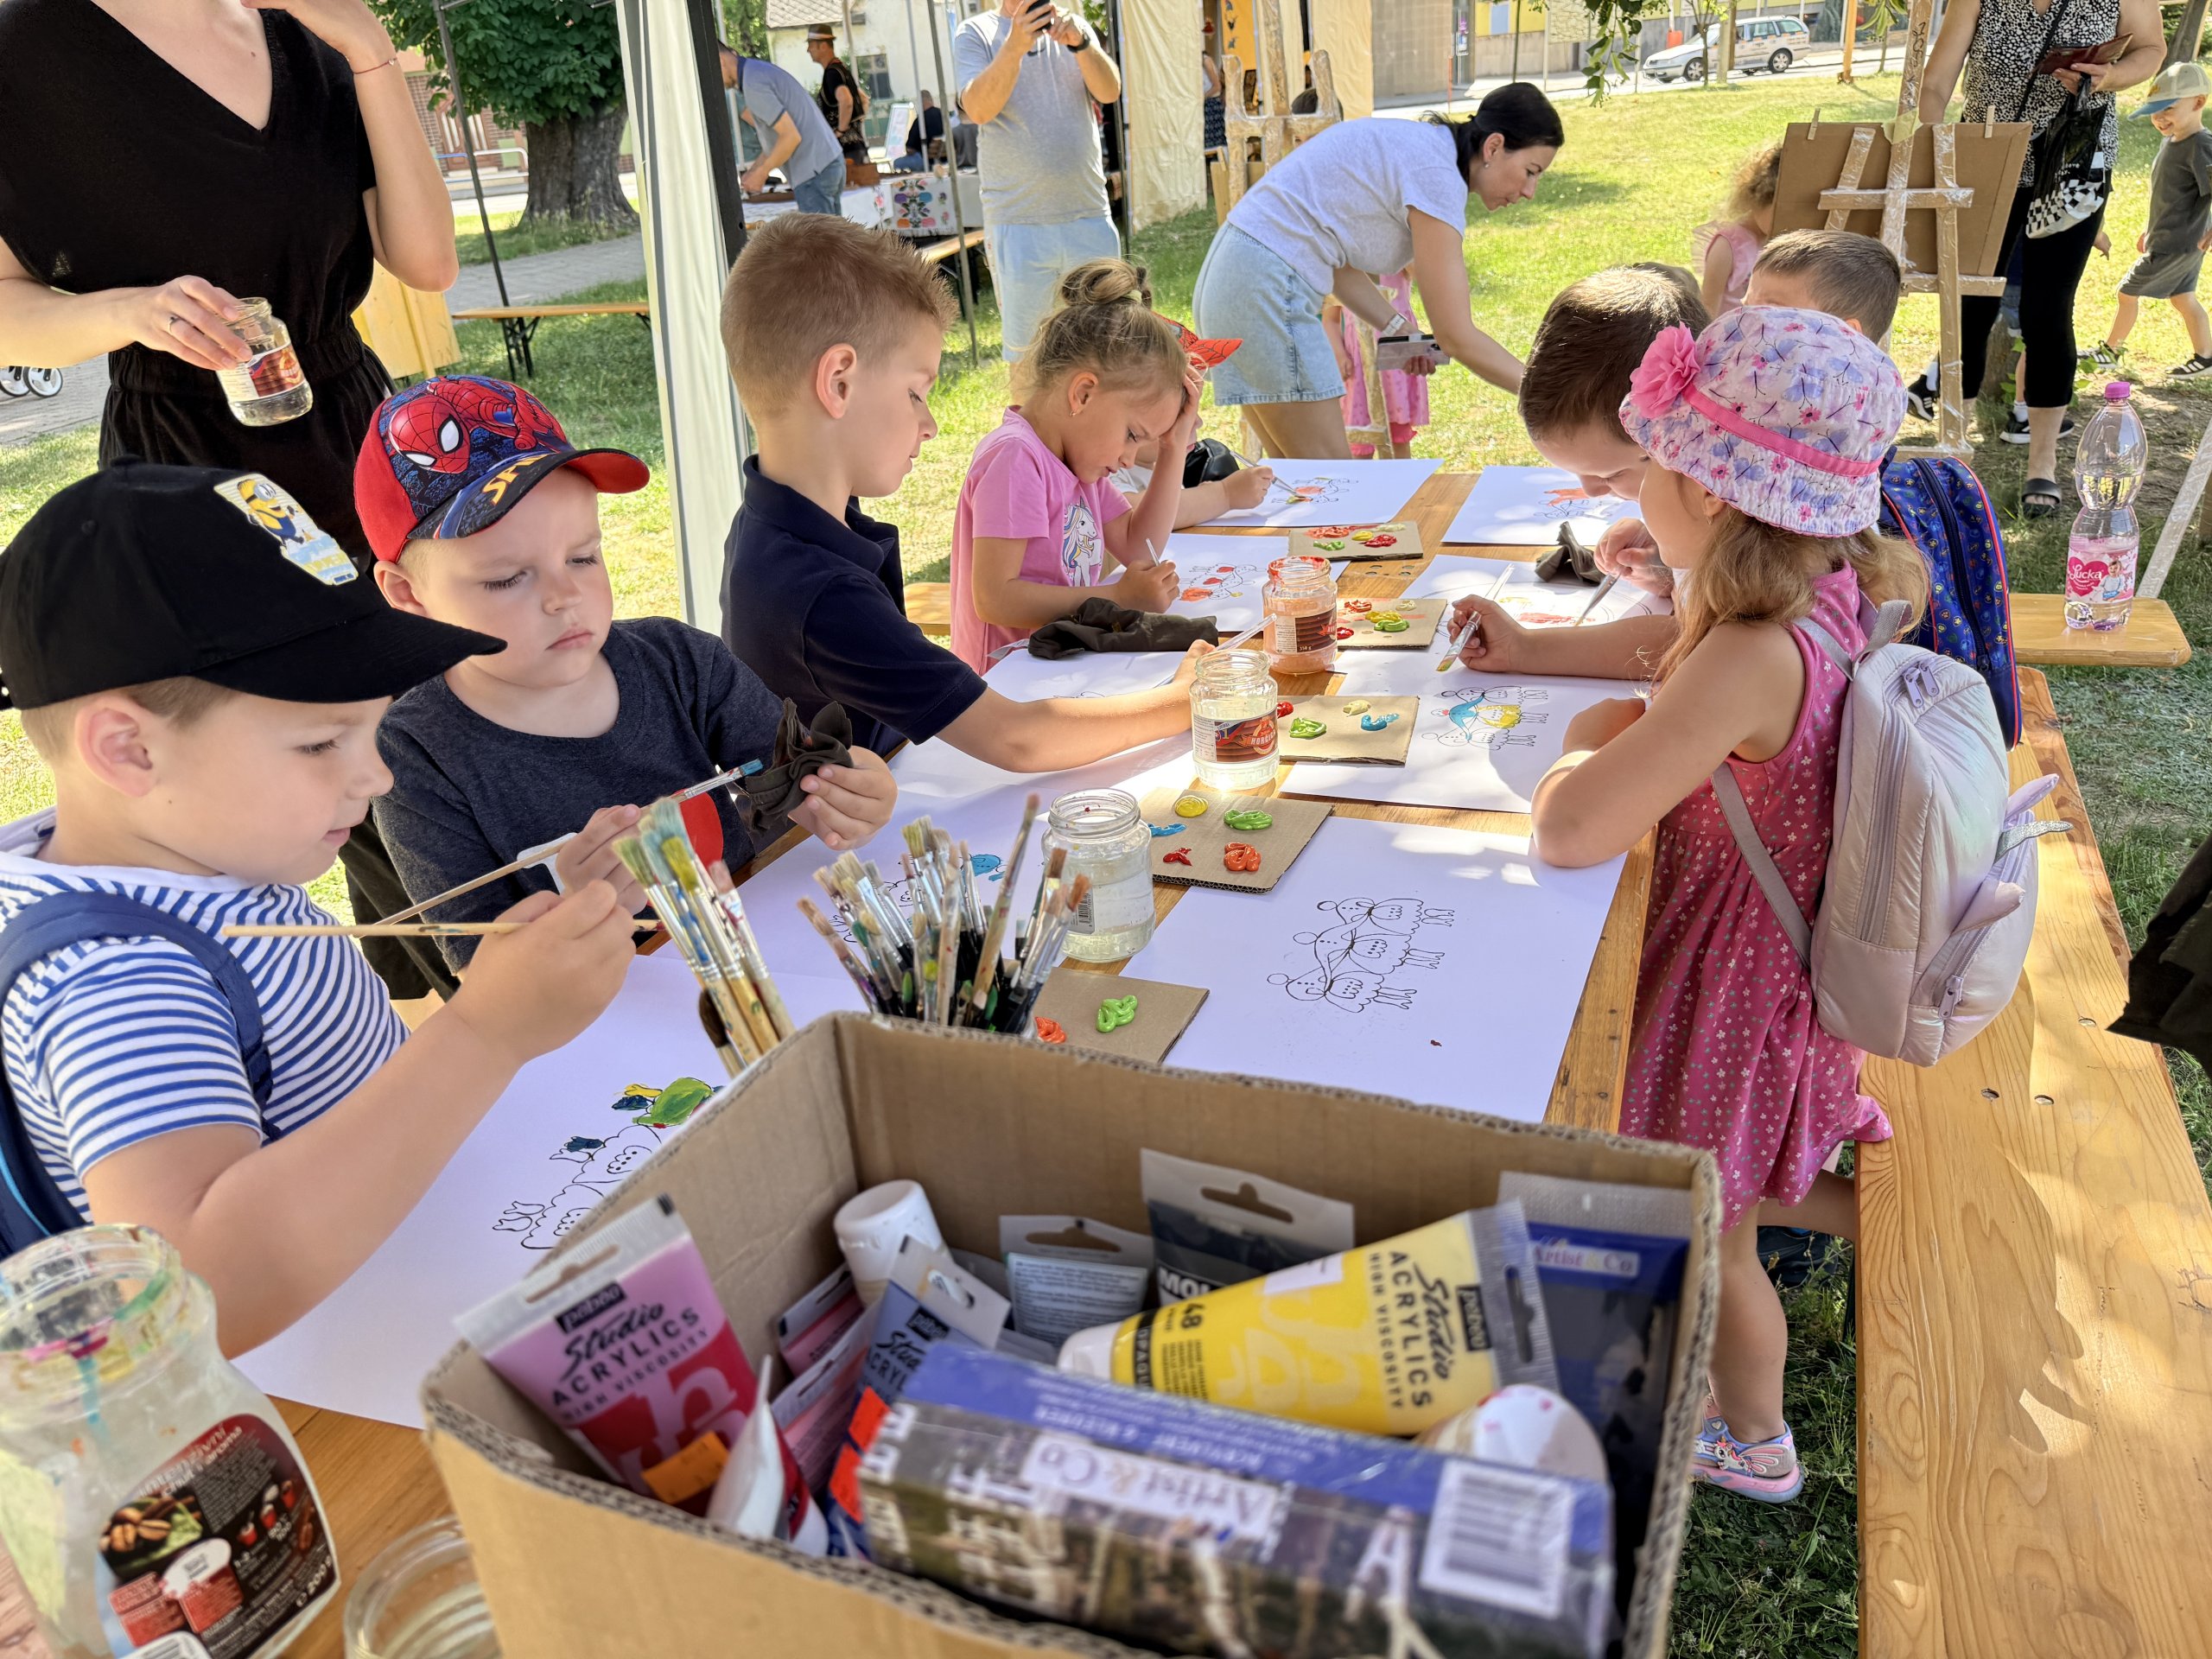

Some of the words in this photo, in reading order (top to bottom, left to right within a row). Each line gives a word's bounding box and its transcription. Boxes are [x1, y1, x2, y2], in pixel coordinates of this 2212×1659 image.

[2069, 564, 2102, 580] Lucka
[550, 1306, 701, 1408] ACRYLICS
[559, 1301, 665, 1383] Studio
[1135, 1328, 1152, 1389] OPAQU
[1369, 1253, 1383, 1300] HIGH
[1376, 1305, 1404, 1409] VISCOSITY
[1388, 1249, 1433, 1408] ACRYLICS
[1413, 1262, 1457, 1382] Studio
[307, 1568, 328, 1595] 200
